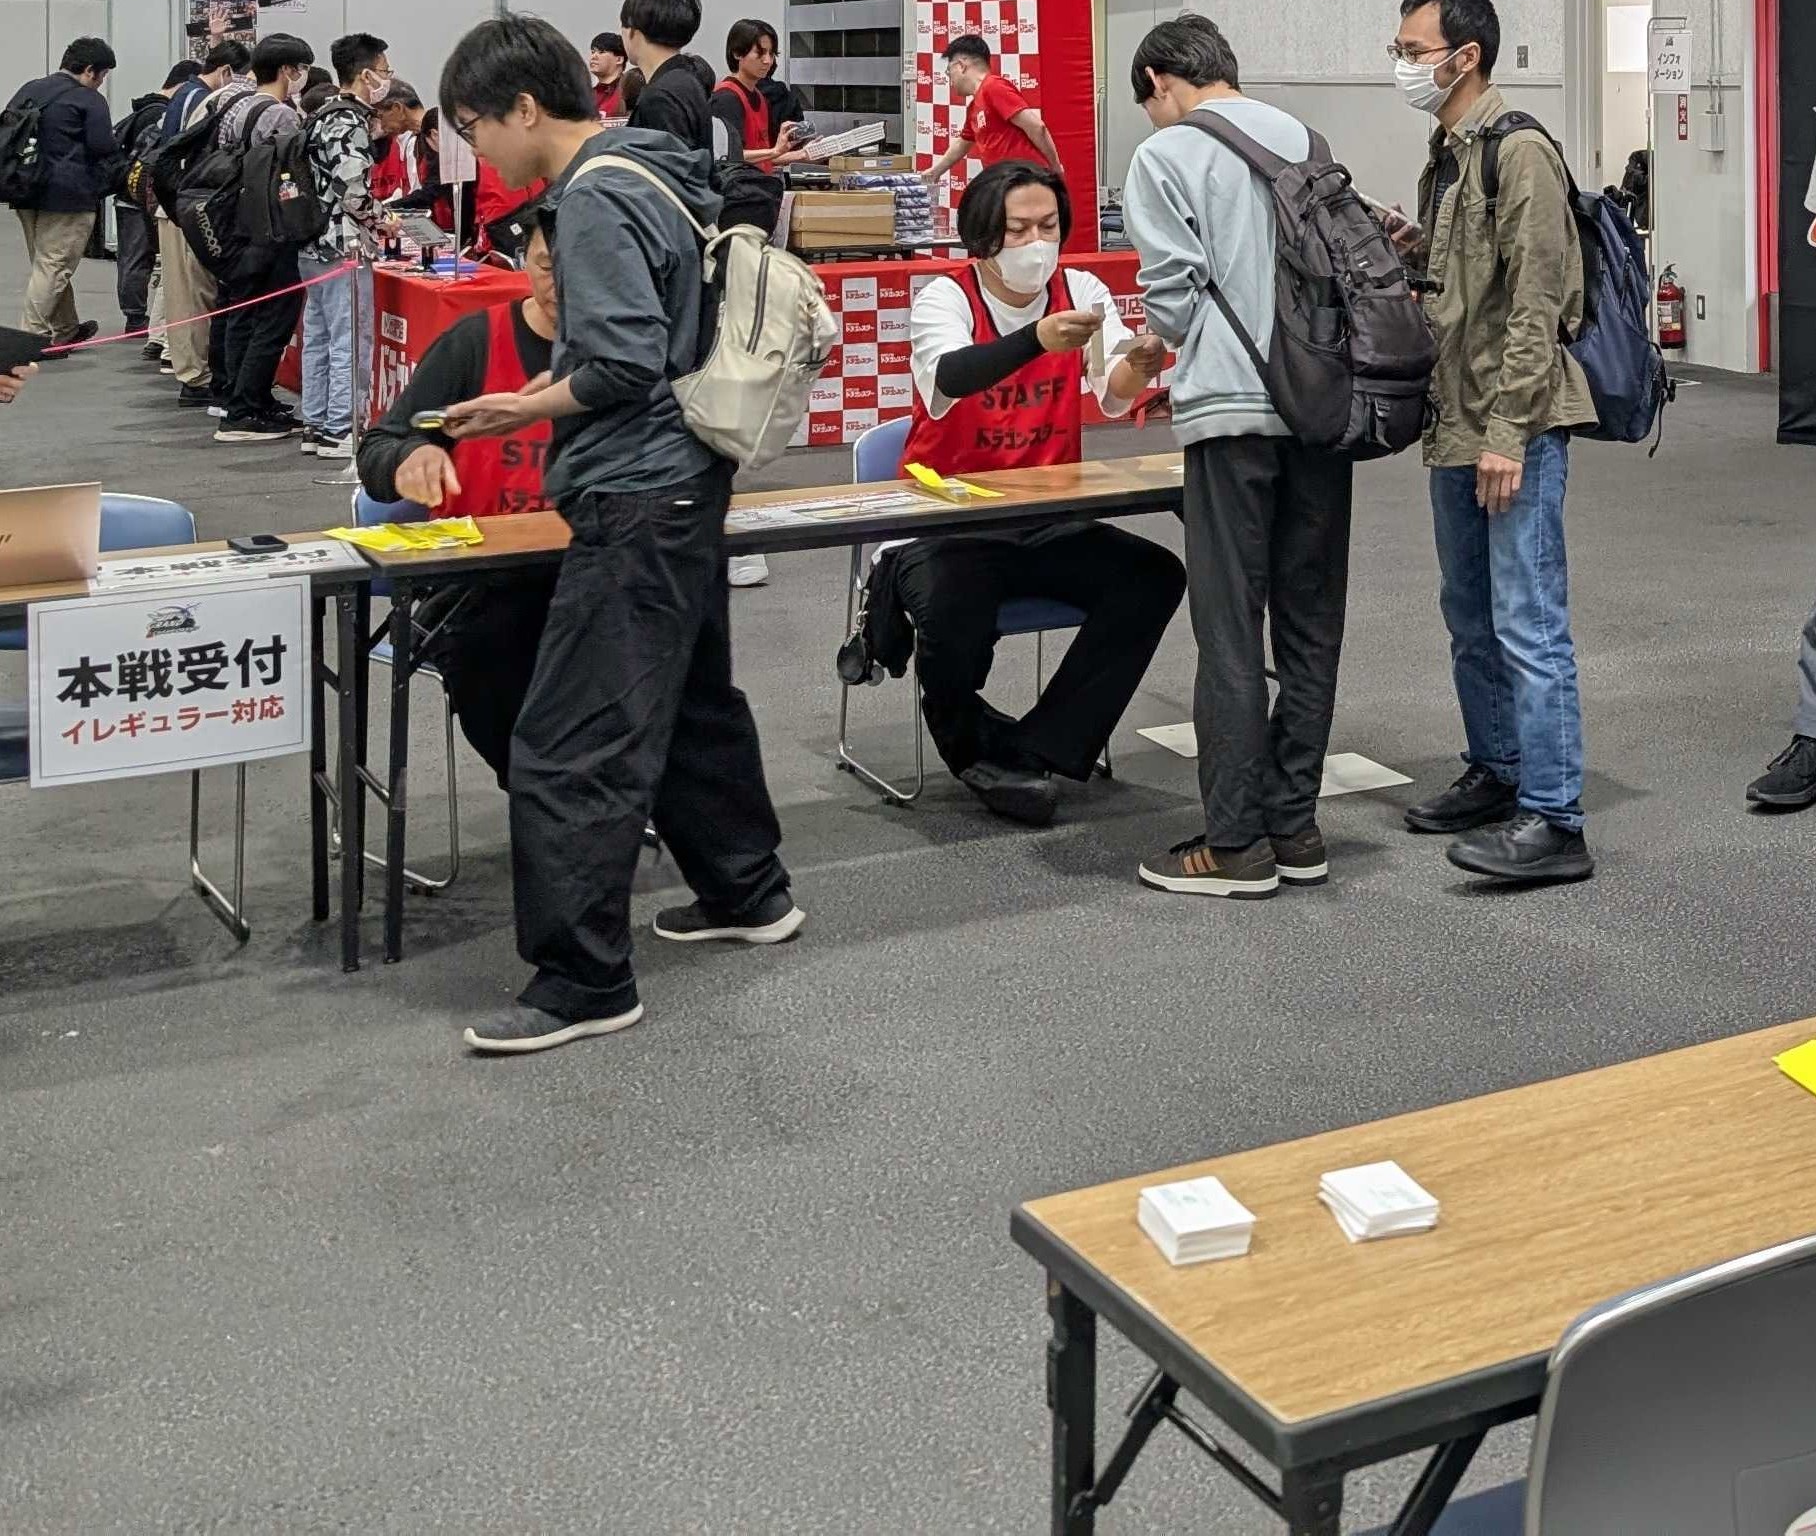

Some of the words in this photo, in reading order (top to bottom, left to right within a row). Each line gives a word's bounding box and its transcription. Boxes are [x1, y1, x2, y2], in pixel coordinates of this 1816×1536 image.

[1657, 52, 1681, 65] インフォ
[1654, 68, 1684, 80] メーション
[983, 376, 1067, 411] STAFF
[975, 423, 1068, 450] ドラゴンスター
[502, 439, 550, 469] ST
[57, 634, 287, 708] 本戦受付
[61, 694, 285, 745] イレギュラー対応
